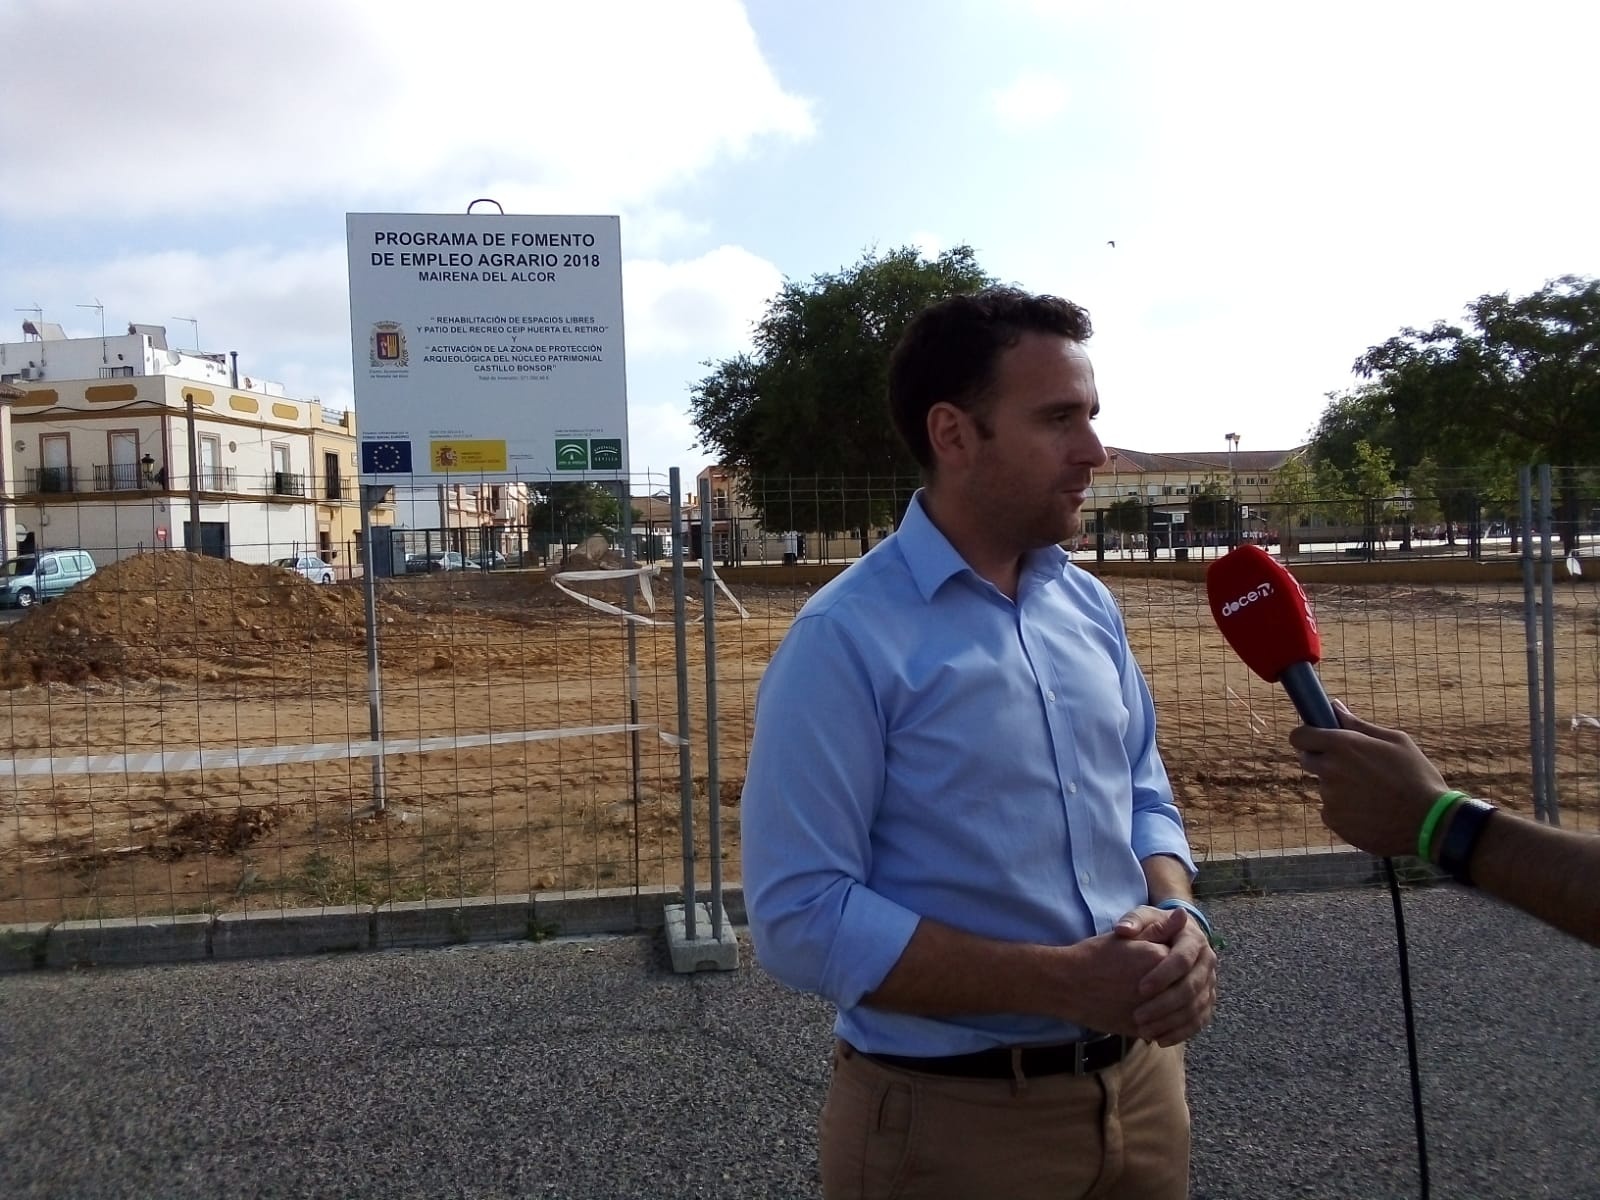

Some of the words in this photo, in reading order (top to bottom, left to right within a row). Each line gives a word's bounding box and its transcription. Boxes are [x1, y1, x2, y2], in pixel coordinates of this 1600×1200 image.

[375, 232, 478, 246] PROGRAMA
[483, 233, 506, 246] DE
[512, 233, 595, 247] FOMENTO
[371, 253, 394, 266] DE
[401, 253, 473, 267] EMPLEO
[478, 254, 558, 267] AGRARIO
[564, 254, 600, 267] 2018
[419, 272, 478, 282] MAIRENA
[482, 272, 507, 282] DEL
[510, 272, 556, 282] ALCOR
